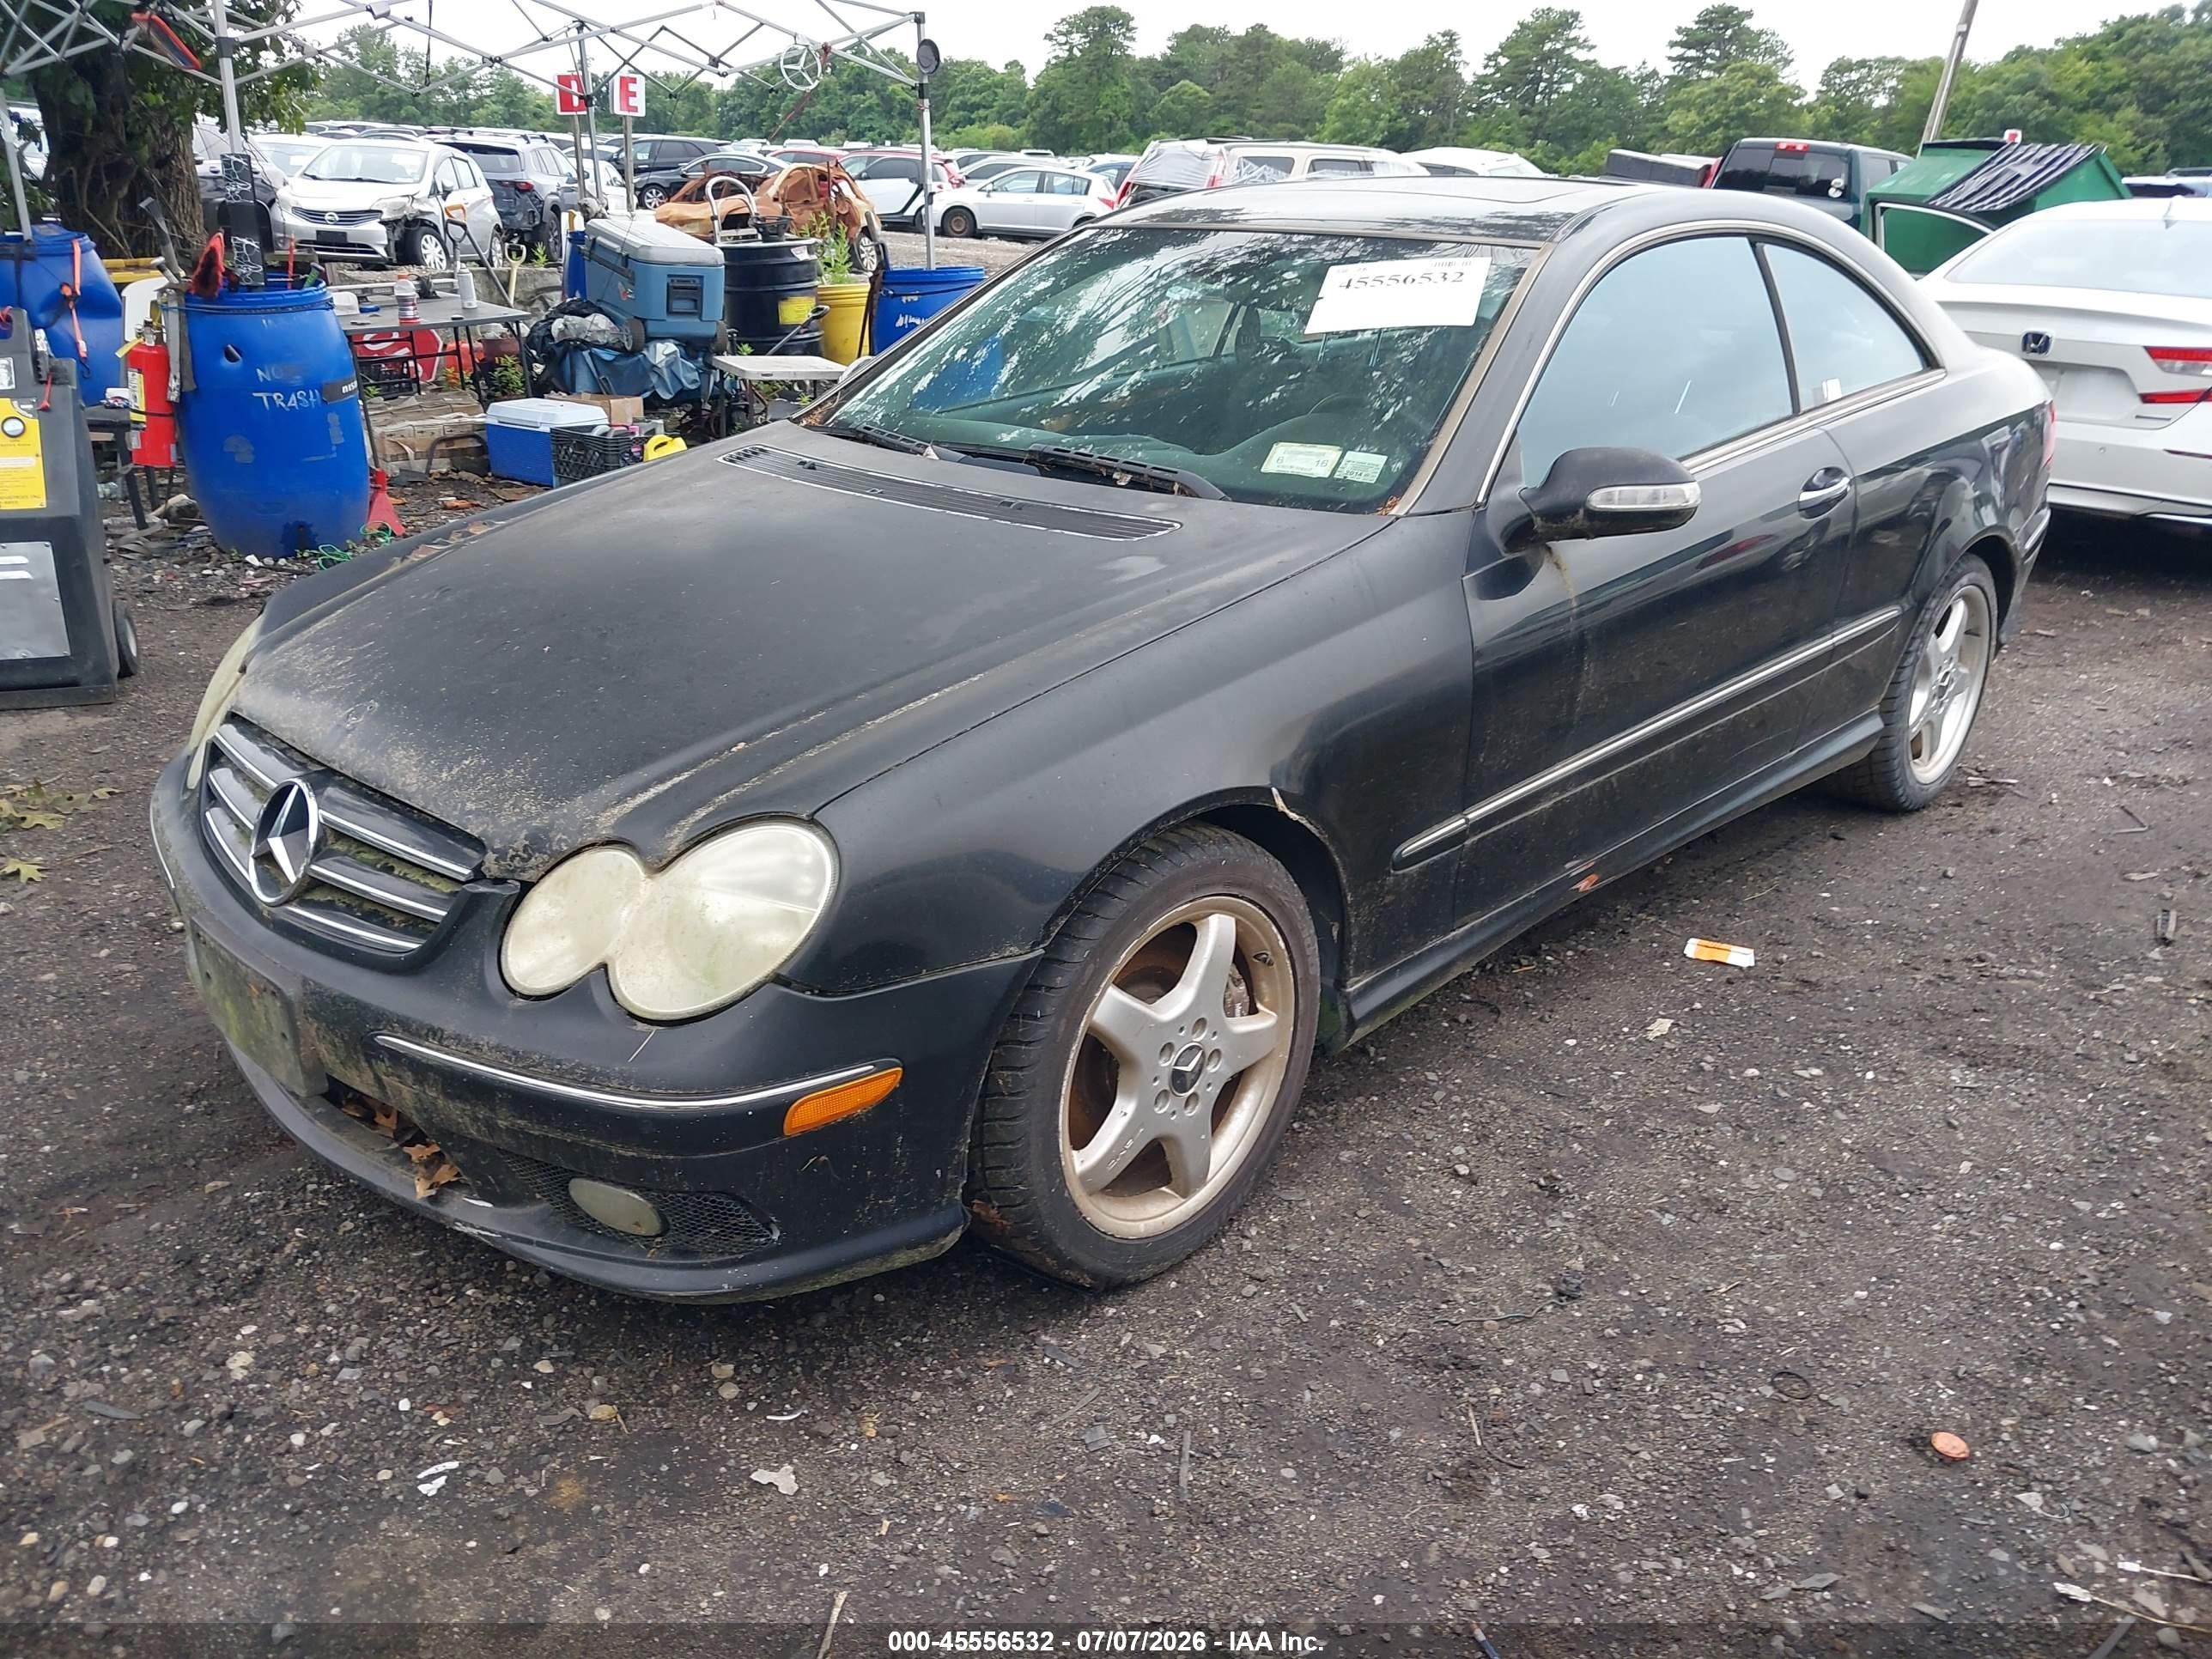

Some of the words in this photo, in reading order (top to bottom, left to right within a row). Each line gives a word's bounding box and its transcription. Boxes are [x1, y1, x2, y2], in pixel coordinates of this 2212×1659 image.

[619, 76, 639, 112] E
[1339, 271, 1465, 289] 45556532
[252, 389, 322, 411] TRASH
